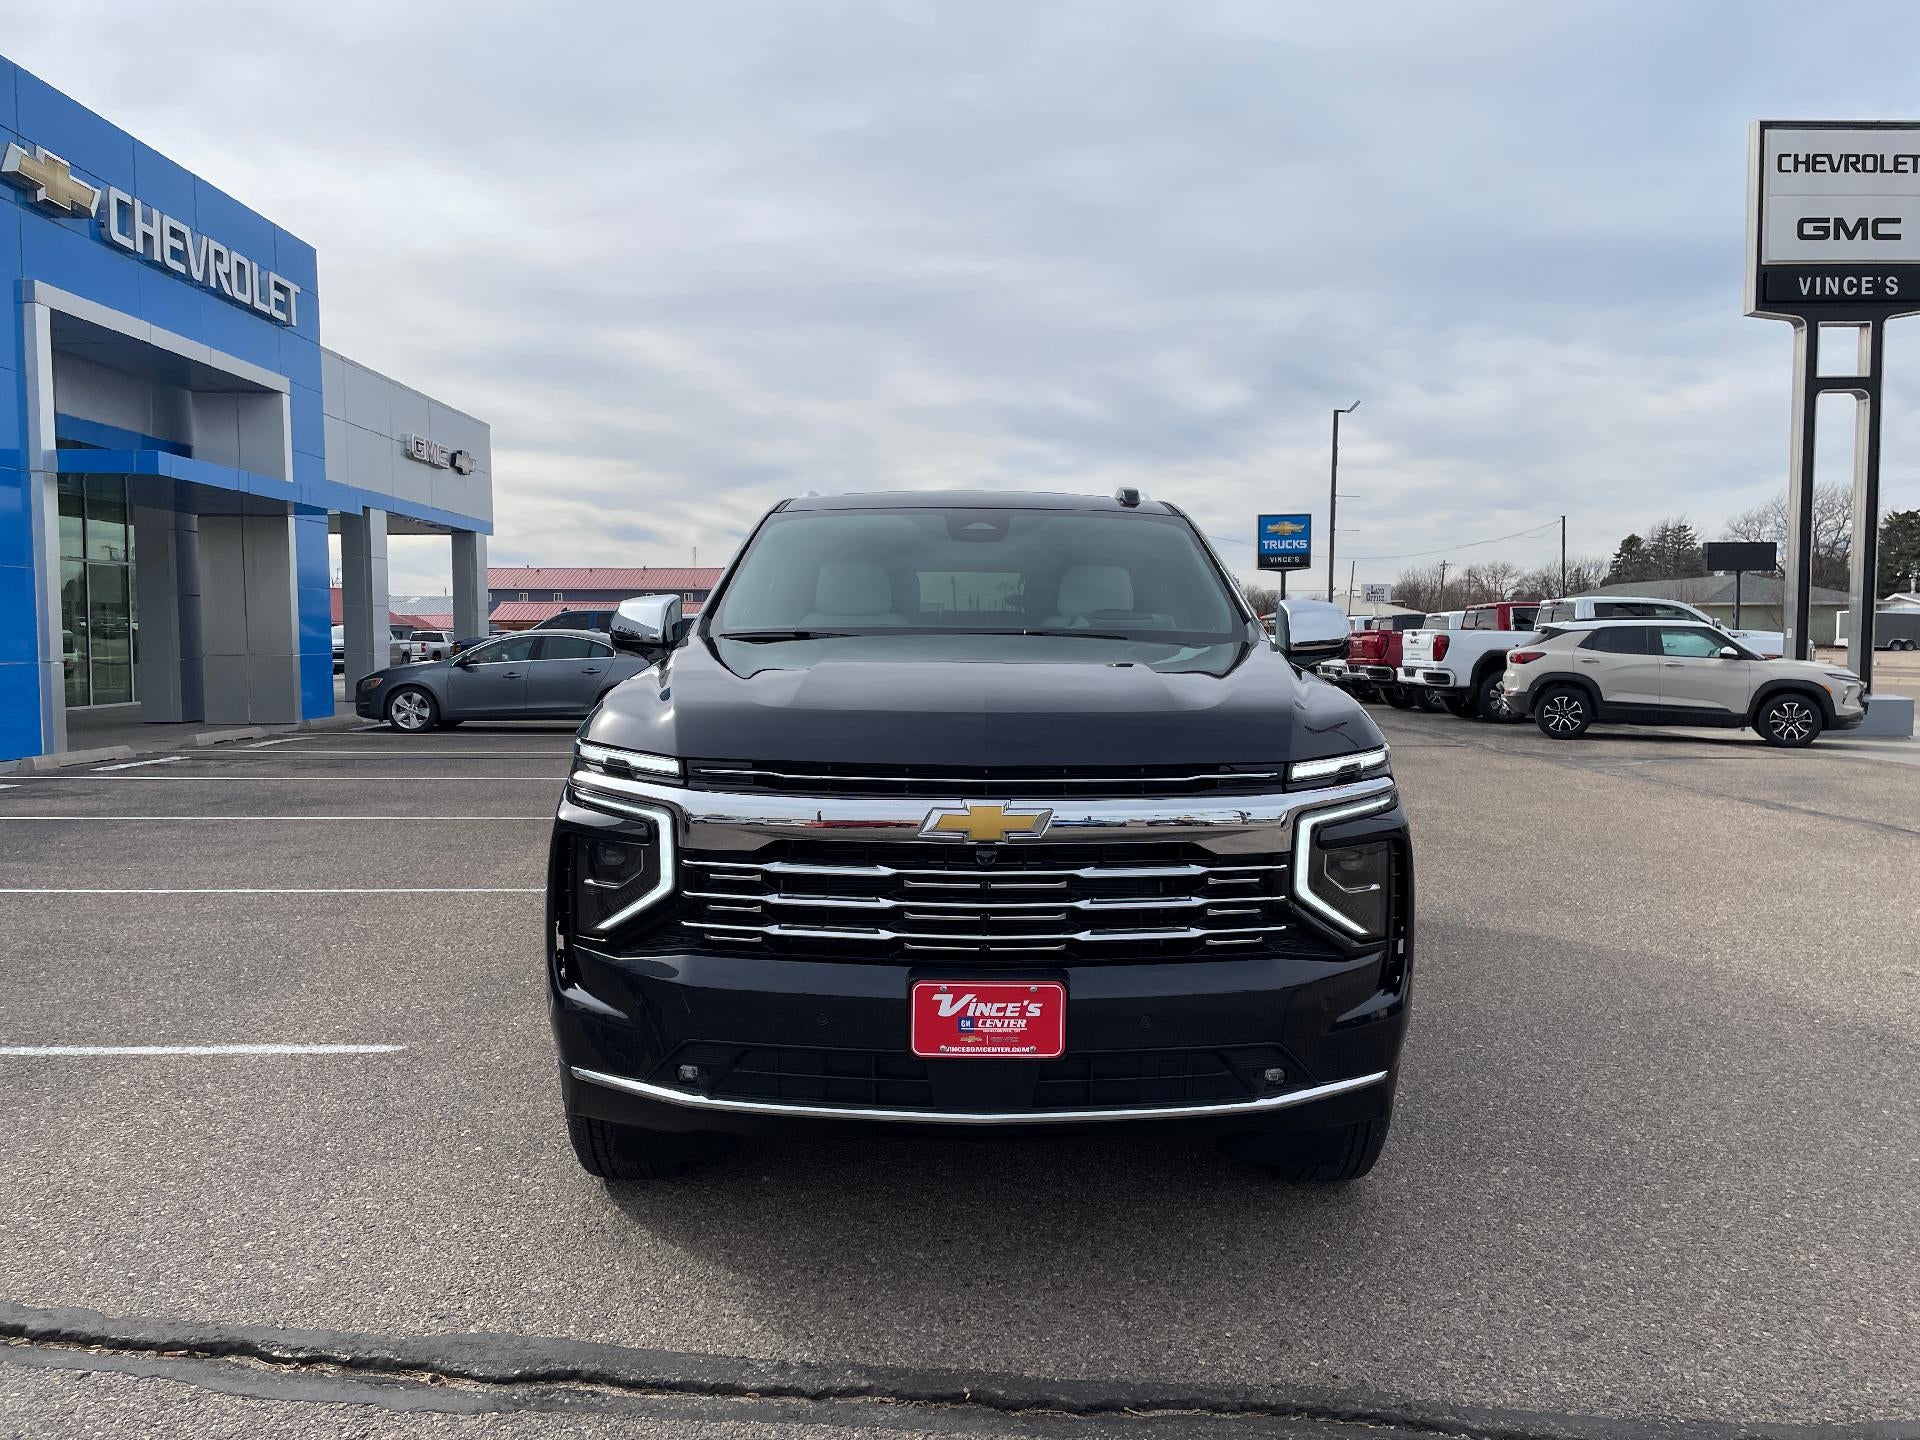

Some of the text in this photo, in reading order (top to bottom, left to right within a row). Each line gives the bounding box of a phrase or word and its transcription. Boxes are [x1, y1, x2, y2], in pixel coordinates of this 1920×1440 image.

[1777, 153, 1920, 174] CHEVROLET
[1797, 217, 1902, 241] GMC
[108, 186, 301, 327] CHEVROLET
[1798, 276, 1899, 296] VINCE'S
[411, 433, 450, 470] GMC
[1262, 539, 1308, 550] TRUCKS
[978, 1019, 1027, 1028] CENTER
